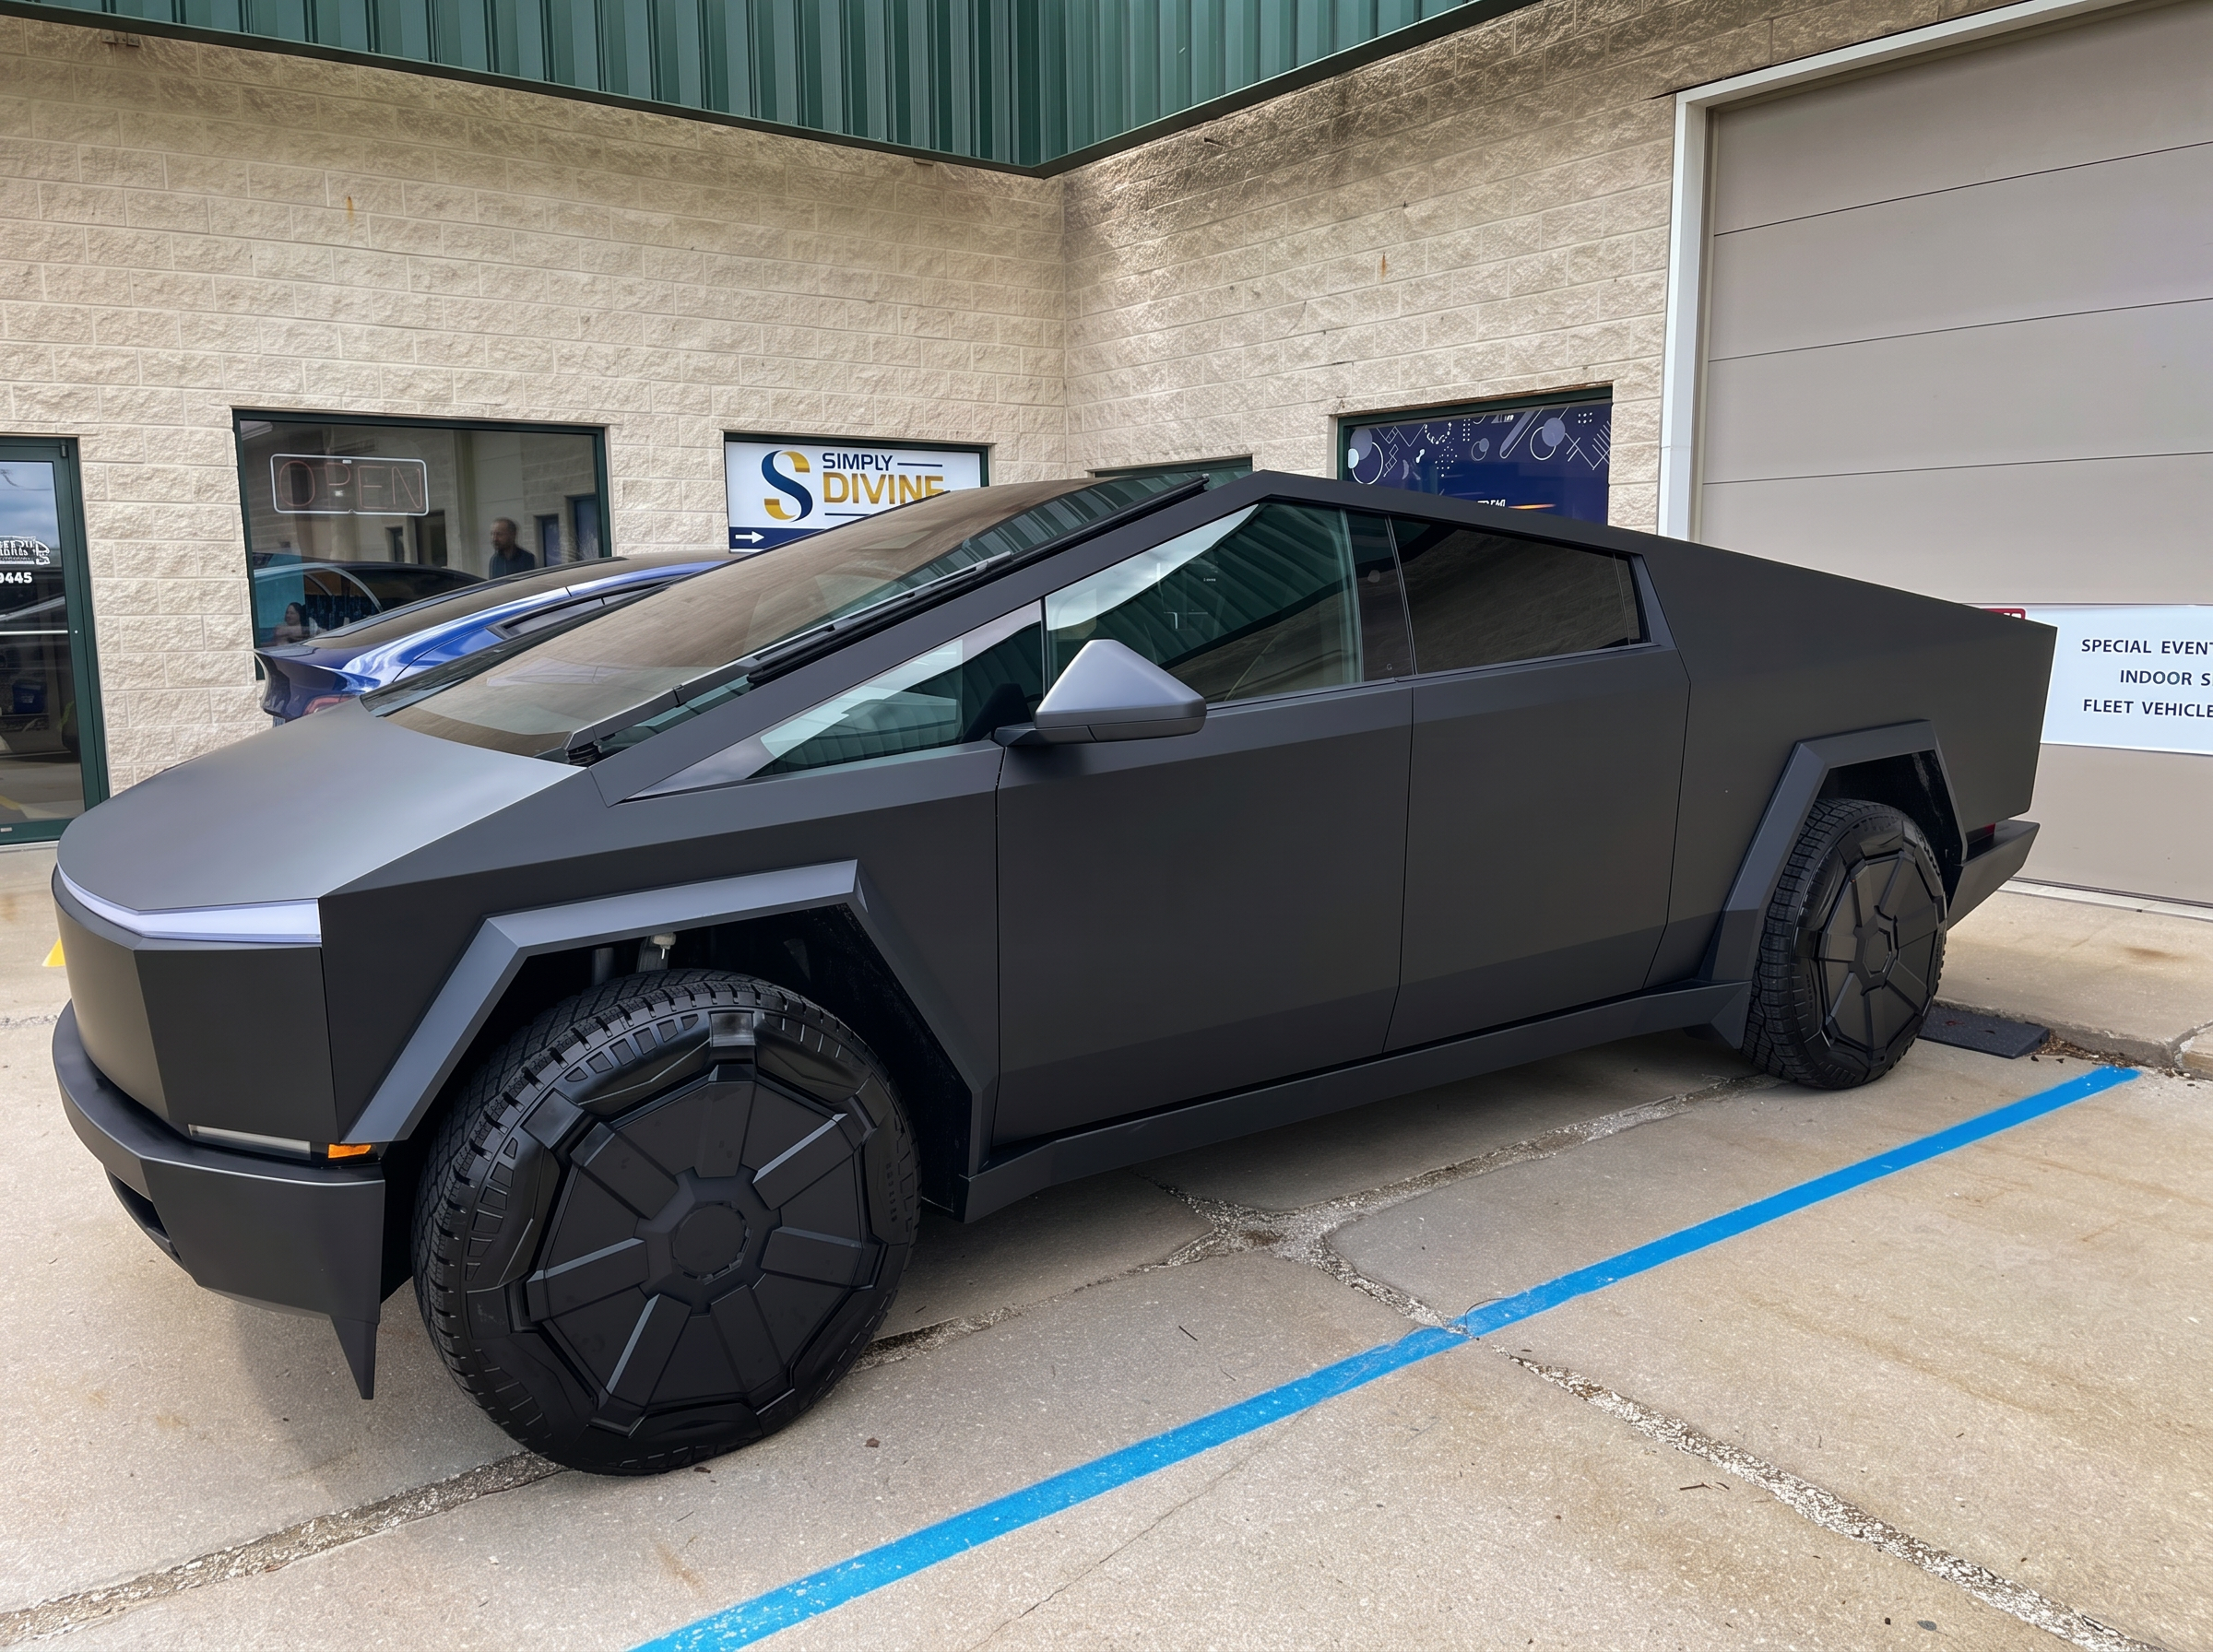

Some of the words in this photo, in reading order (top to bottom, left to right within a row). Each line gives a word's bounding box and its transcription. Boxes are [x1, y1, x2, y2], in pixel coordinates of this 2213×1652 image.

[822, 452, 893, 471] SIMPLY
[278, 460, 423, 509] OPEN
[822, 471, 944, 505] DIVINE
[2081, 639, 2152, 654] SPECIAL
[2120, 669, 2193, 686] INDOOR
[2200, 672, 2213, 687] S
[2083, 699, 2135, 714] FLEET
[2141, 701, 2213, 718] VEHICLE
